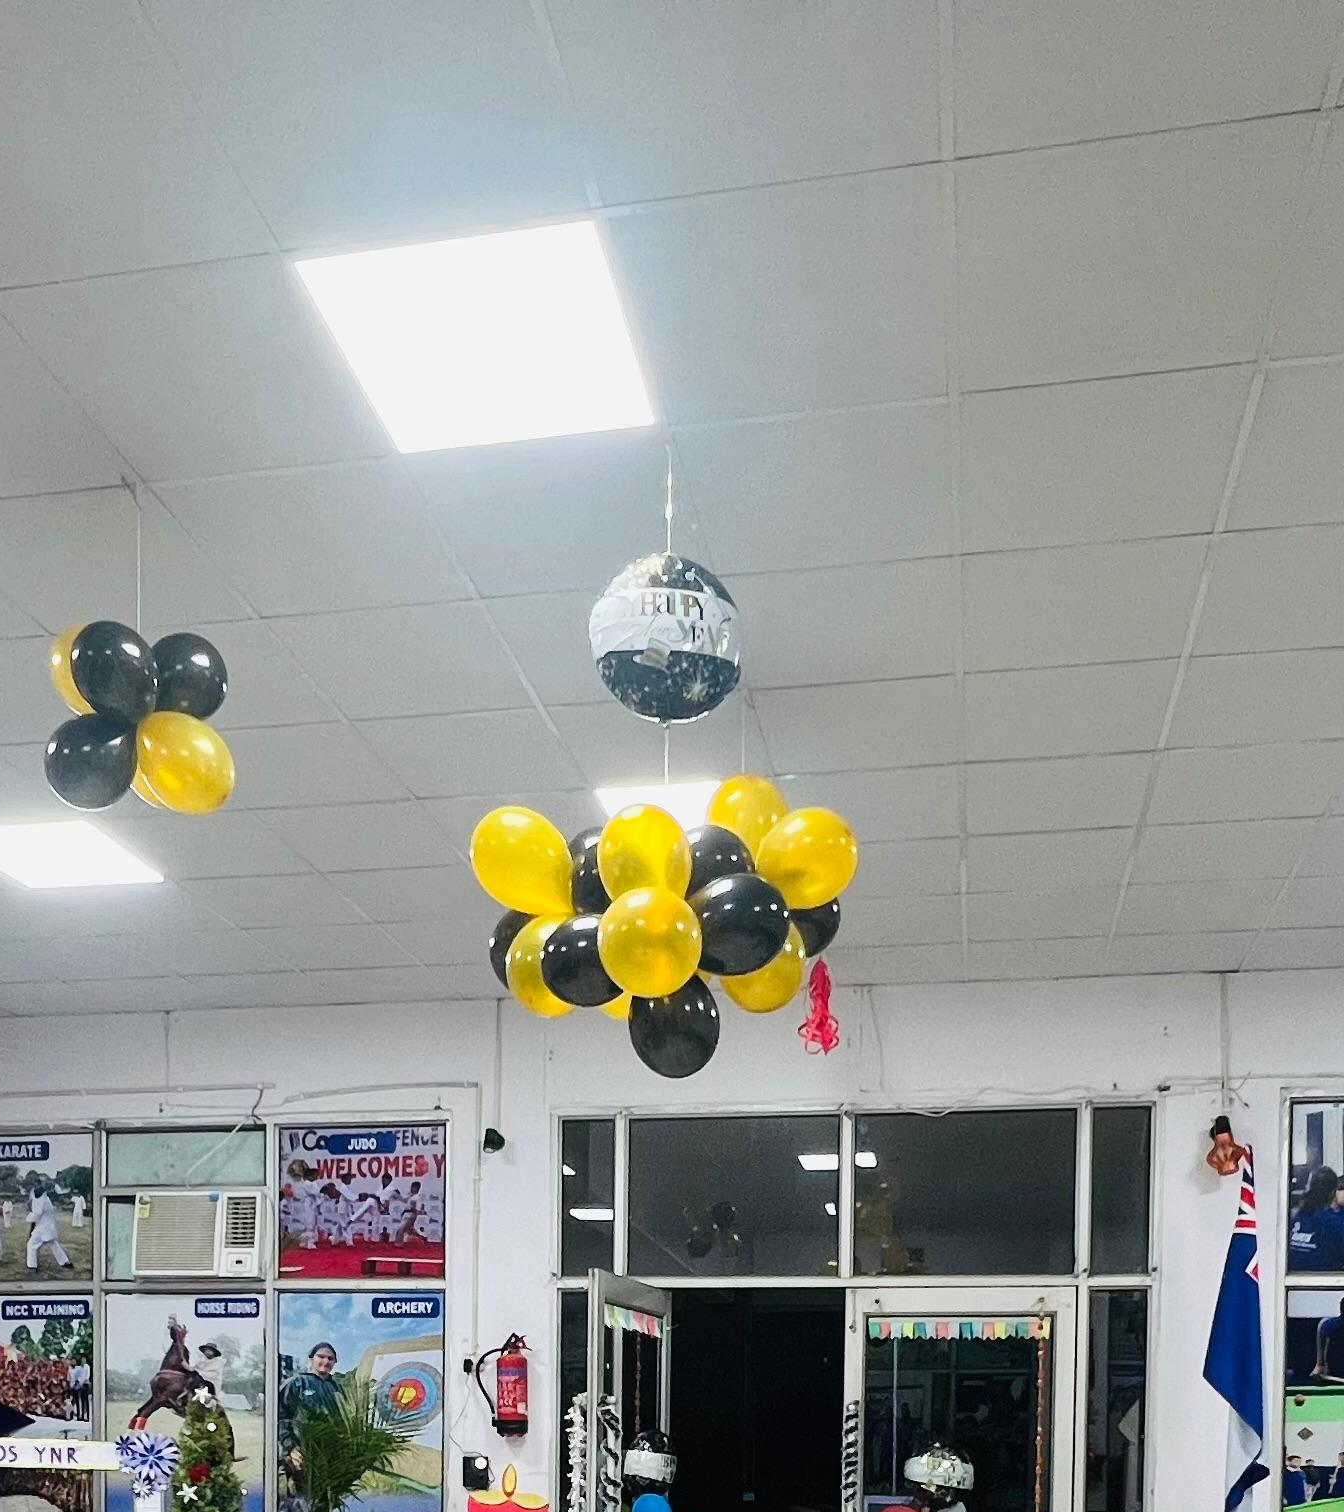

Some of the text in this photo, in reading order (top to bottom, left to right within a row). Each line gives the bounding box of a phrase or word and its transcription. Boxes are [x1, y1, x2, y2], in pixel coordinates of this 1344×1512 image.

[347, 1137, 377, 1151] JUDO
[6, 1303, 85, 1317] NCC TRAINING
[196, 1302, 226, 1315] HORSE
[377, 1301, 434, 1314] ARCHERY
[33, 1445, 79, 1465] YNR
